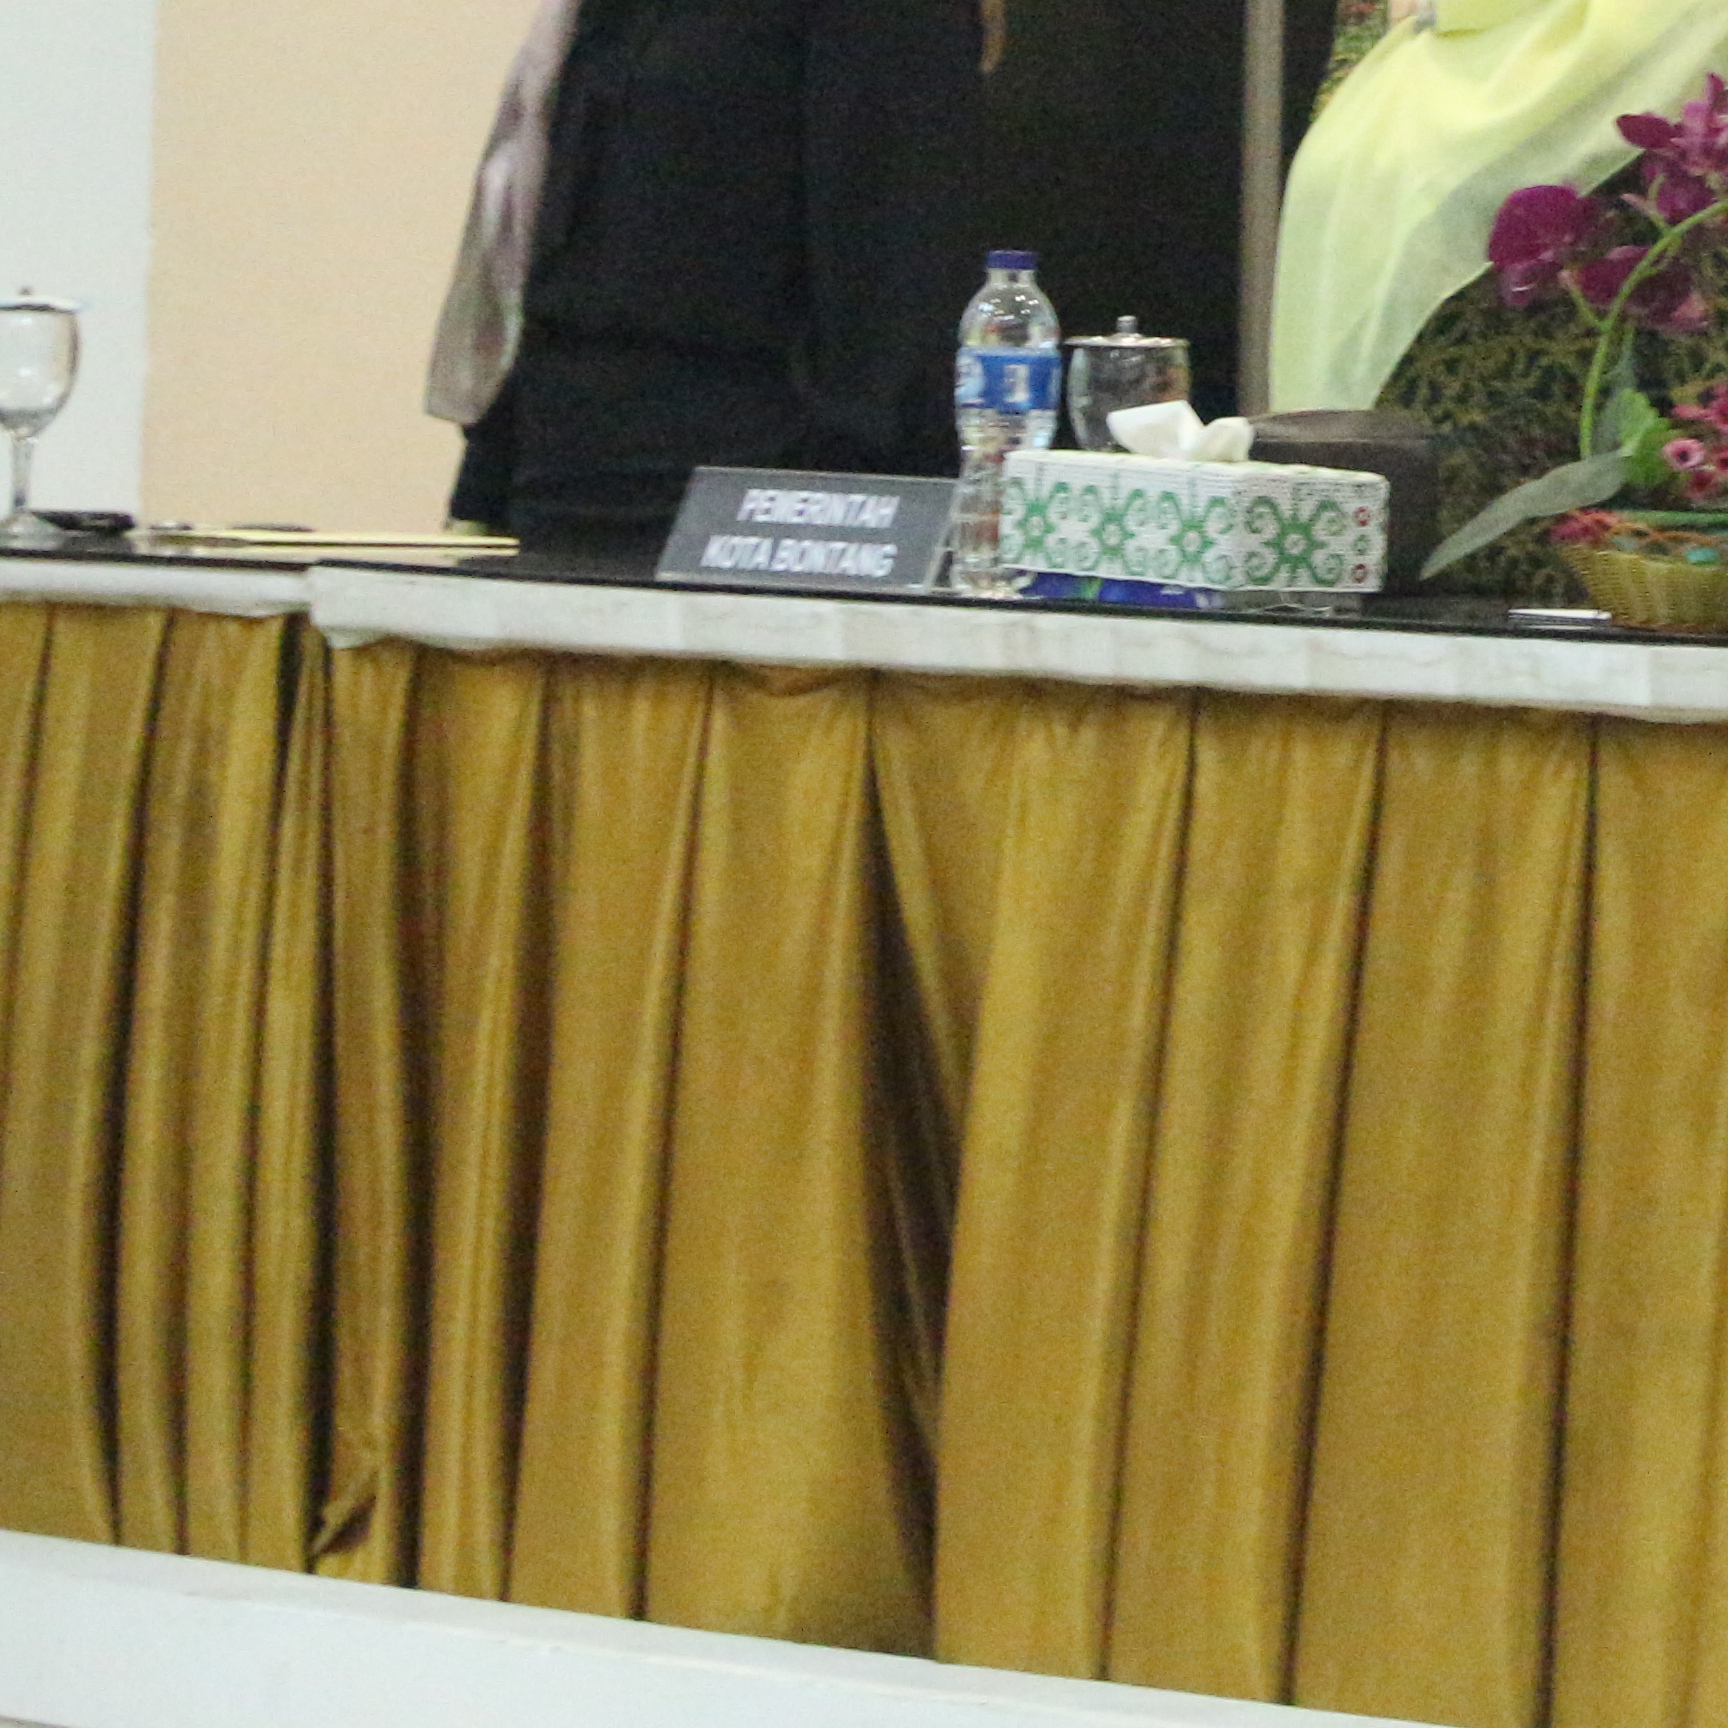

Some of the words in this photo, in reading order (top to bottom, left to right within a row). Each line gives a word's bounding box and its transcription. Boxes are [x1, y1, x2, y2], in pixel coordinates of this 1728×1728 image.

[736, 488, 901, 529] PEMERINTAH
[700, 534, 775, 571] KOTA
[770, 538, 899, 578] BONTANG
